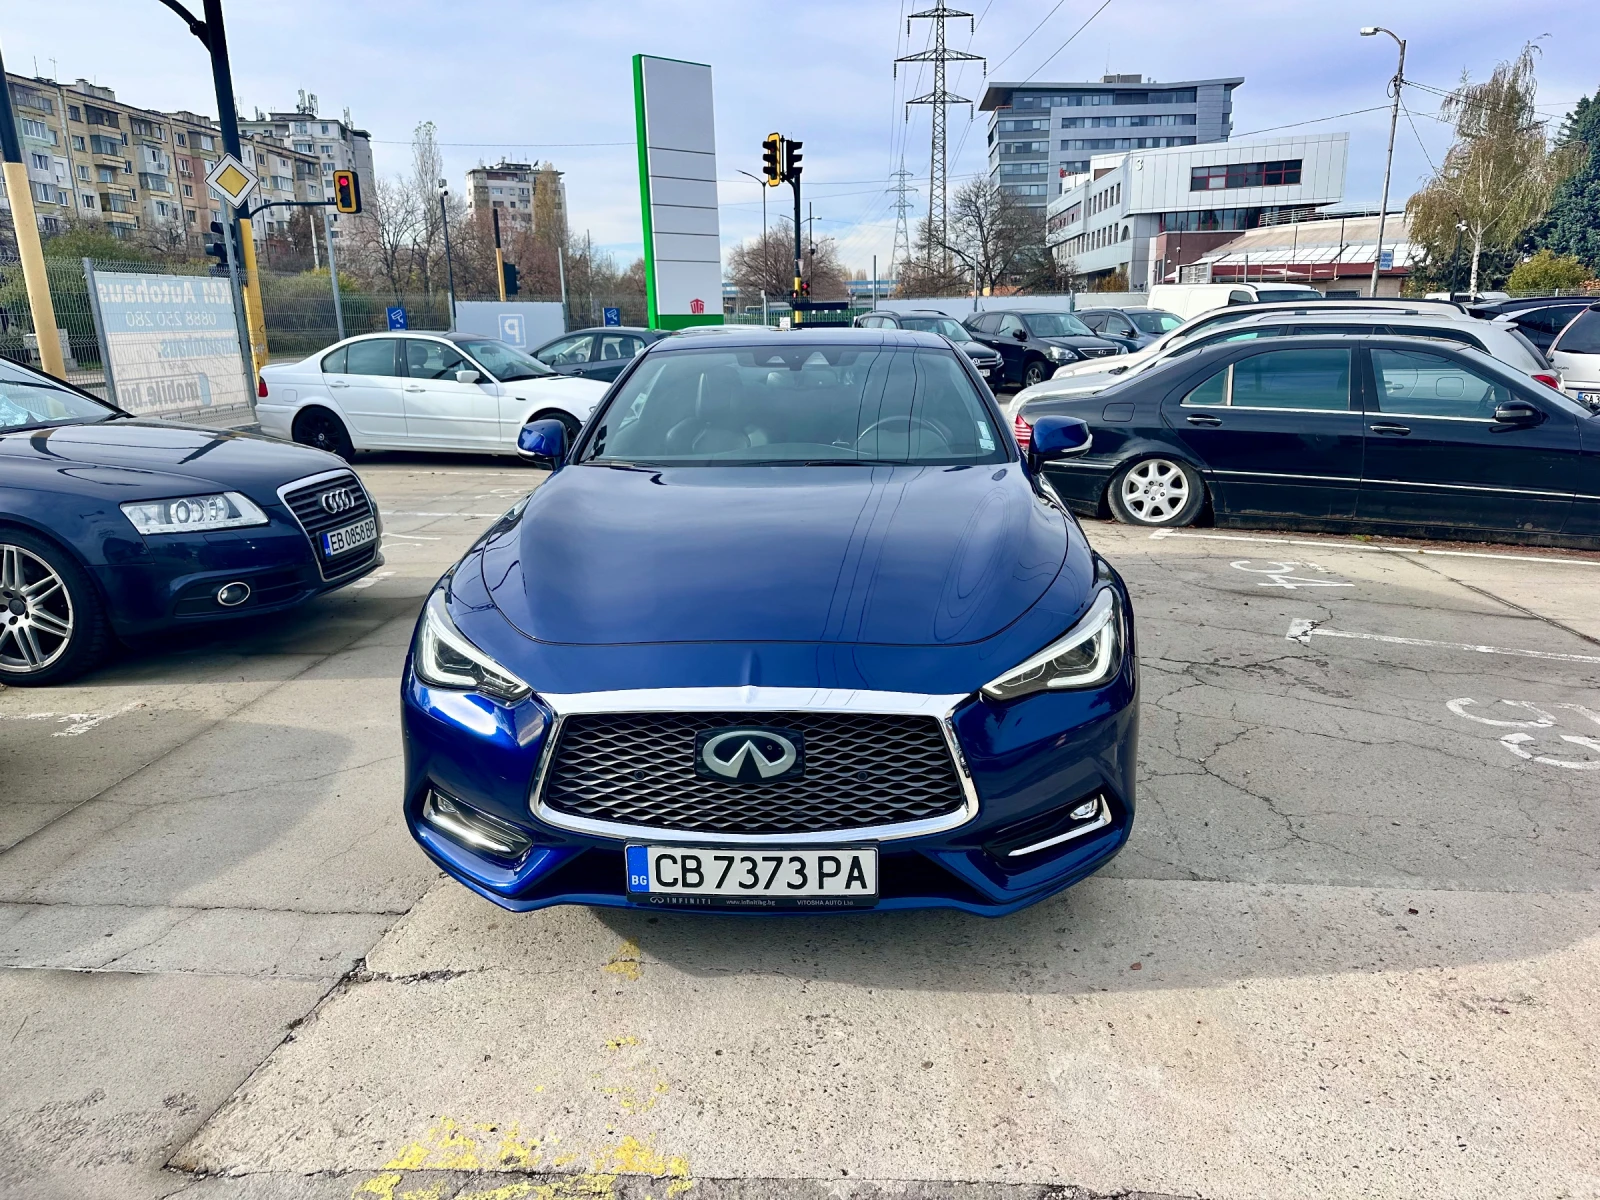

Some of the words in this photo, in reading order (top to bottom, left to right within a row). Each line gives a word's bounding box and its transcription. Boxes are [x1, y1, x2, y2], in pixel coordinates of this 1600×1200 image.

[689, 298, 705, 314] UTA
[330, 533, 344, 552] EB
[345, 524, 365, 546] 0858
[1229, 559, 1355, 590] 54
[631, 874, 648, 886] BG
[654, 853, 705, 888] CB
[713, 855, 808, 890] 7373
[817, 855, 868, 890] PA
[667, 896, 711, 905] INFINITI
